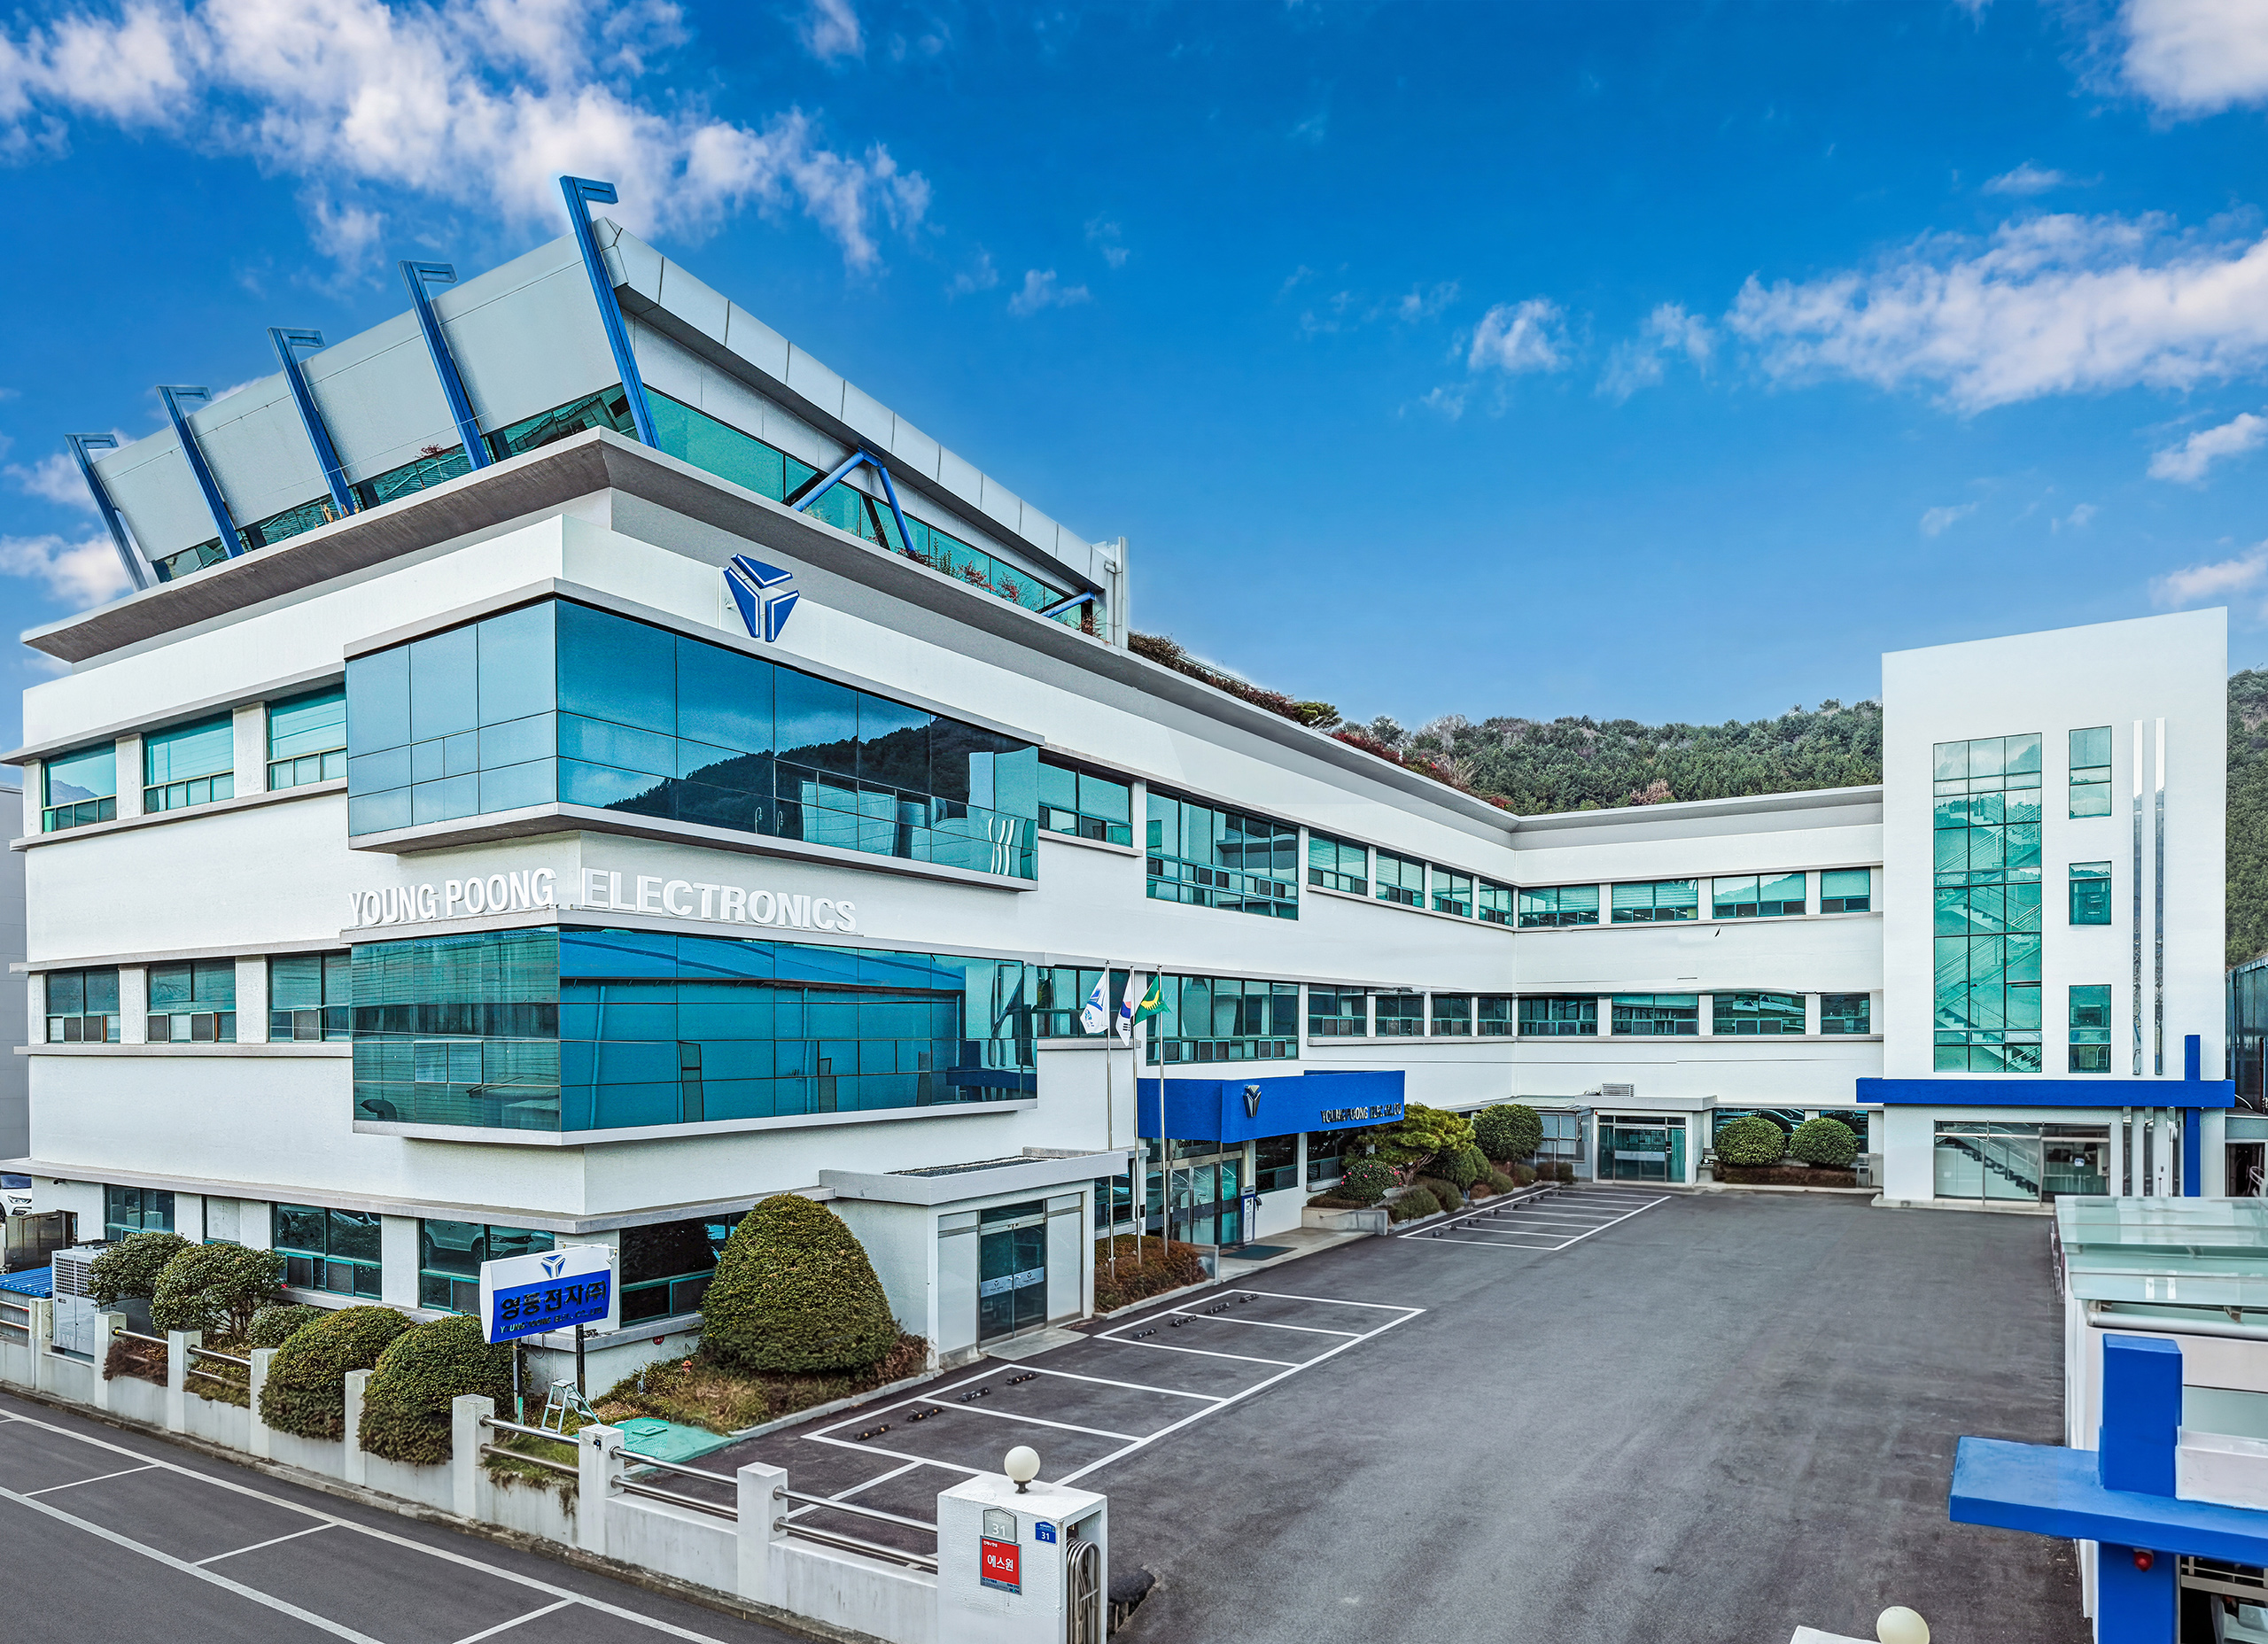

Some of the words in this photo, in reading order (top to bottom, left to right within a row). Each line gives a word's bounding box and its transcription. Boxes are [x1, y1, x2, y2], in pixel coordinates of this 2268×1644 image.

[348, 881, 440, 927] YOUNG
[445, 867, 557, 917] POONG
[580, 867, 858, 932] ELECTRONICS
[501, 1280, 607, 1320] 영풍전자(주)
[991, 1523, 1006, 1537] 31
[1041, 1531, 1050, 1540] 31
[987, 1554, 1014, 1572] 에스원
